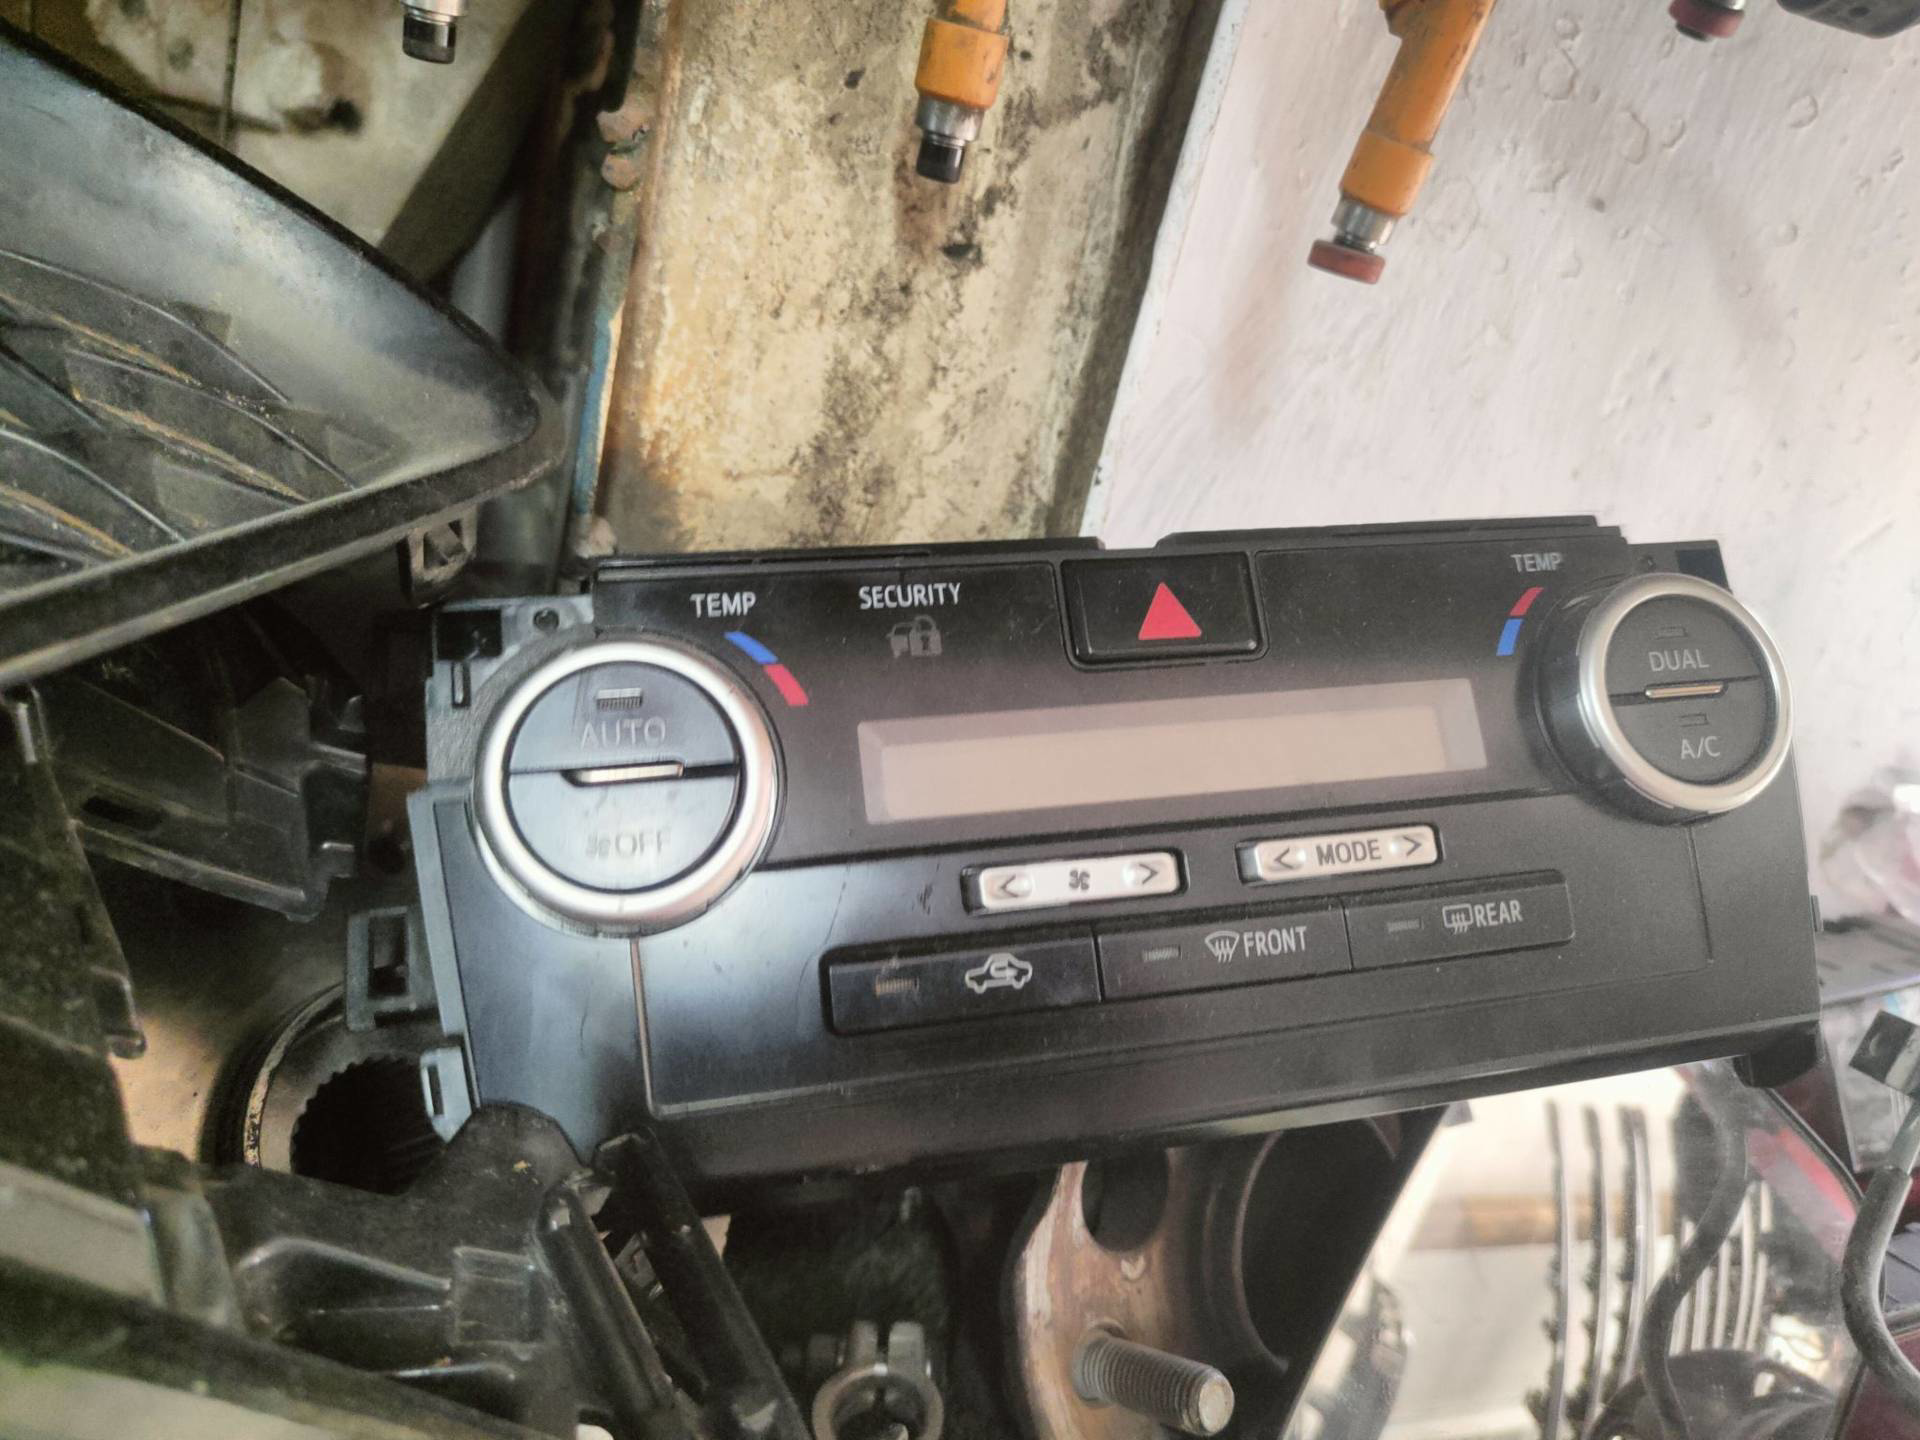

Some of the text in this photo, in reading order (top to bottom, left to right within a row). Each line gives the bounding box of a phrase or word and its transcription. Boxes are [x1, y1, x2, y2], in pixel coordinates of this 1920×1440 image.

[1511, 552, 1564, 573] TEMP
[690, 591, 757, 618] TEMP
[859, 582, 961, 611] SECURITY
[1648, 649, 1711, 672] DUAL
[580, 716, 667, 750] AUTO
[1680, 735, 1721, 759] A/C
[614, 829, 672, 857] OFF
[1316, 837, 1382, 867] MODE
[1474, 900, 1522, 926] REAR
[1243, 925, 1308, 959] FRONT
